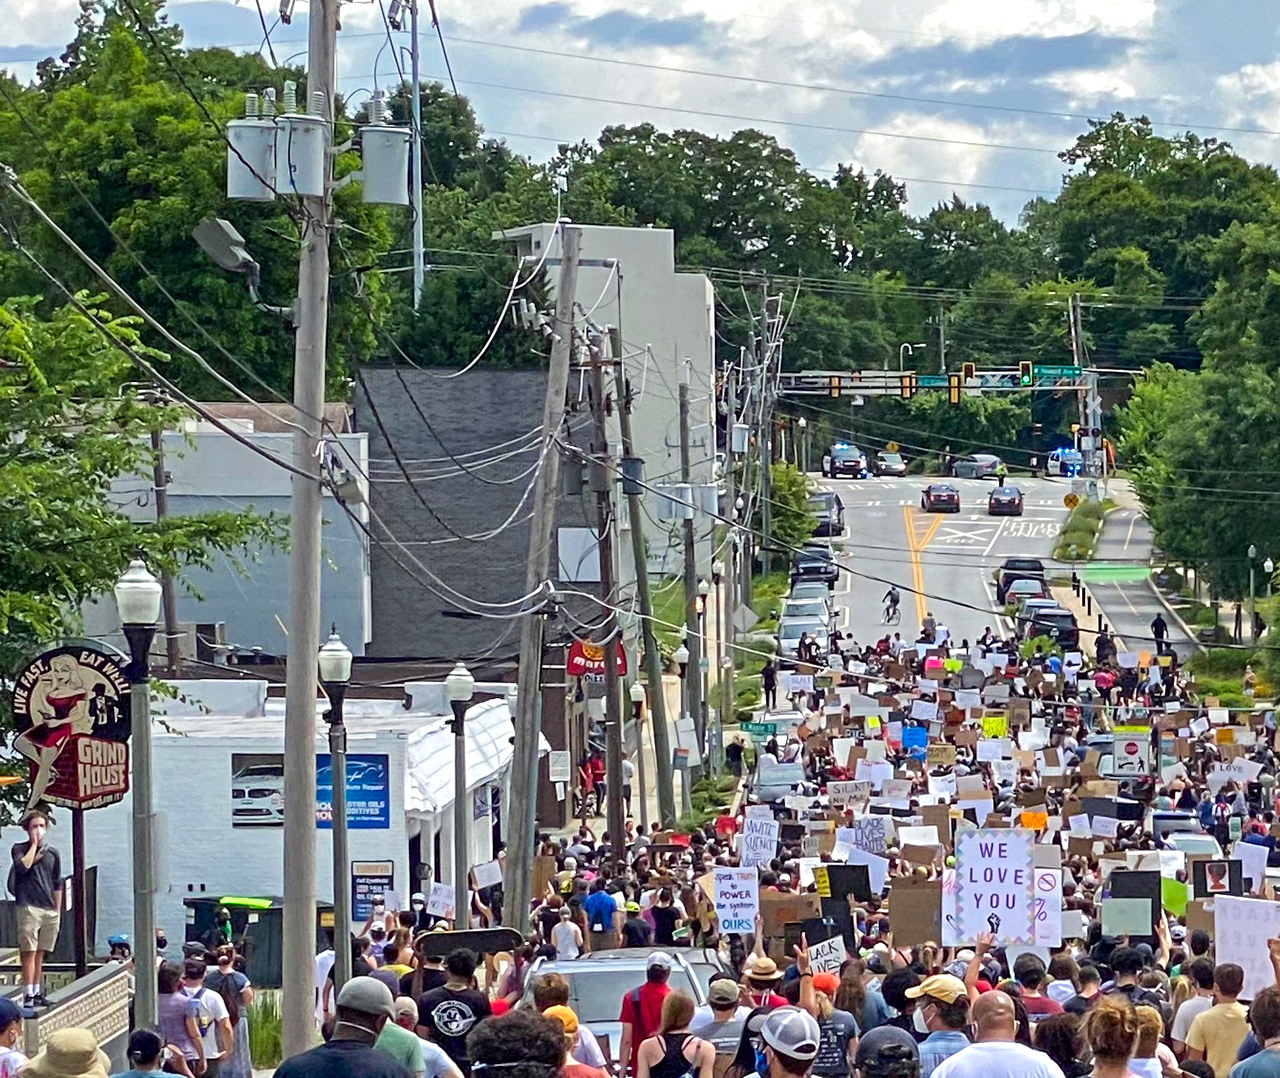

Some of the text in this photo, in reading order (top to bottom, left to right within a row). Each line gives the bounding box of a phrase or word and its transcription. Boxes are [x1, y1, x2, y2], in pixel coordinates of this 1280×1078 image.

[14, 650, 132, 715] LIVE FAST, EAT WELL!
[77, 737, 127, 765] GRIND
[1220, 764, 1244, 773] LOVE
[77, 763, 127, 797] HOUSE
[855, 829, 886, 842] LIVES
[979, 842, 1008, 858] WE
[969, 867, 1024, 885] LOVE
[720, 890, 752, 899] POWER
[973, 893, 1016, 910] YOU
[722, 919, 753, 930] OURS
[810, 940, 839, 961] LACK
